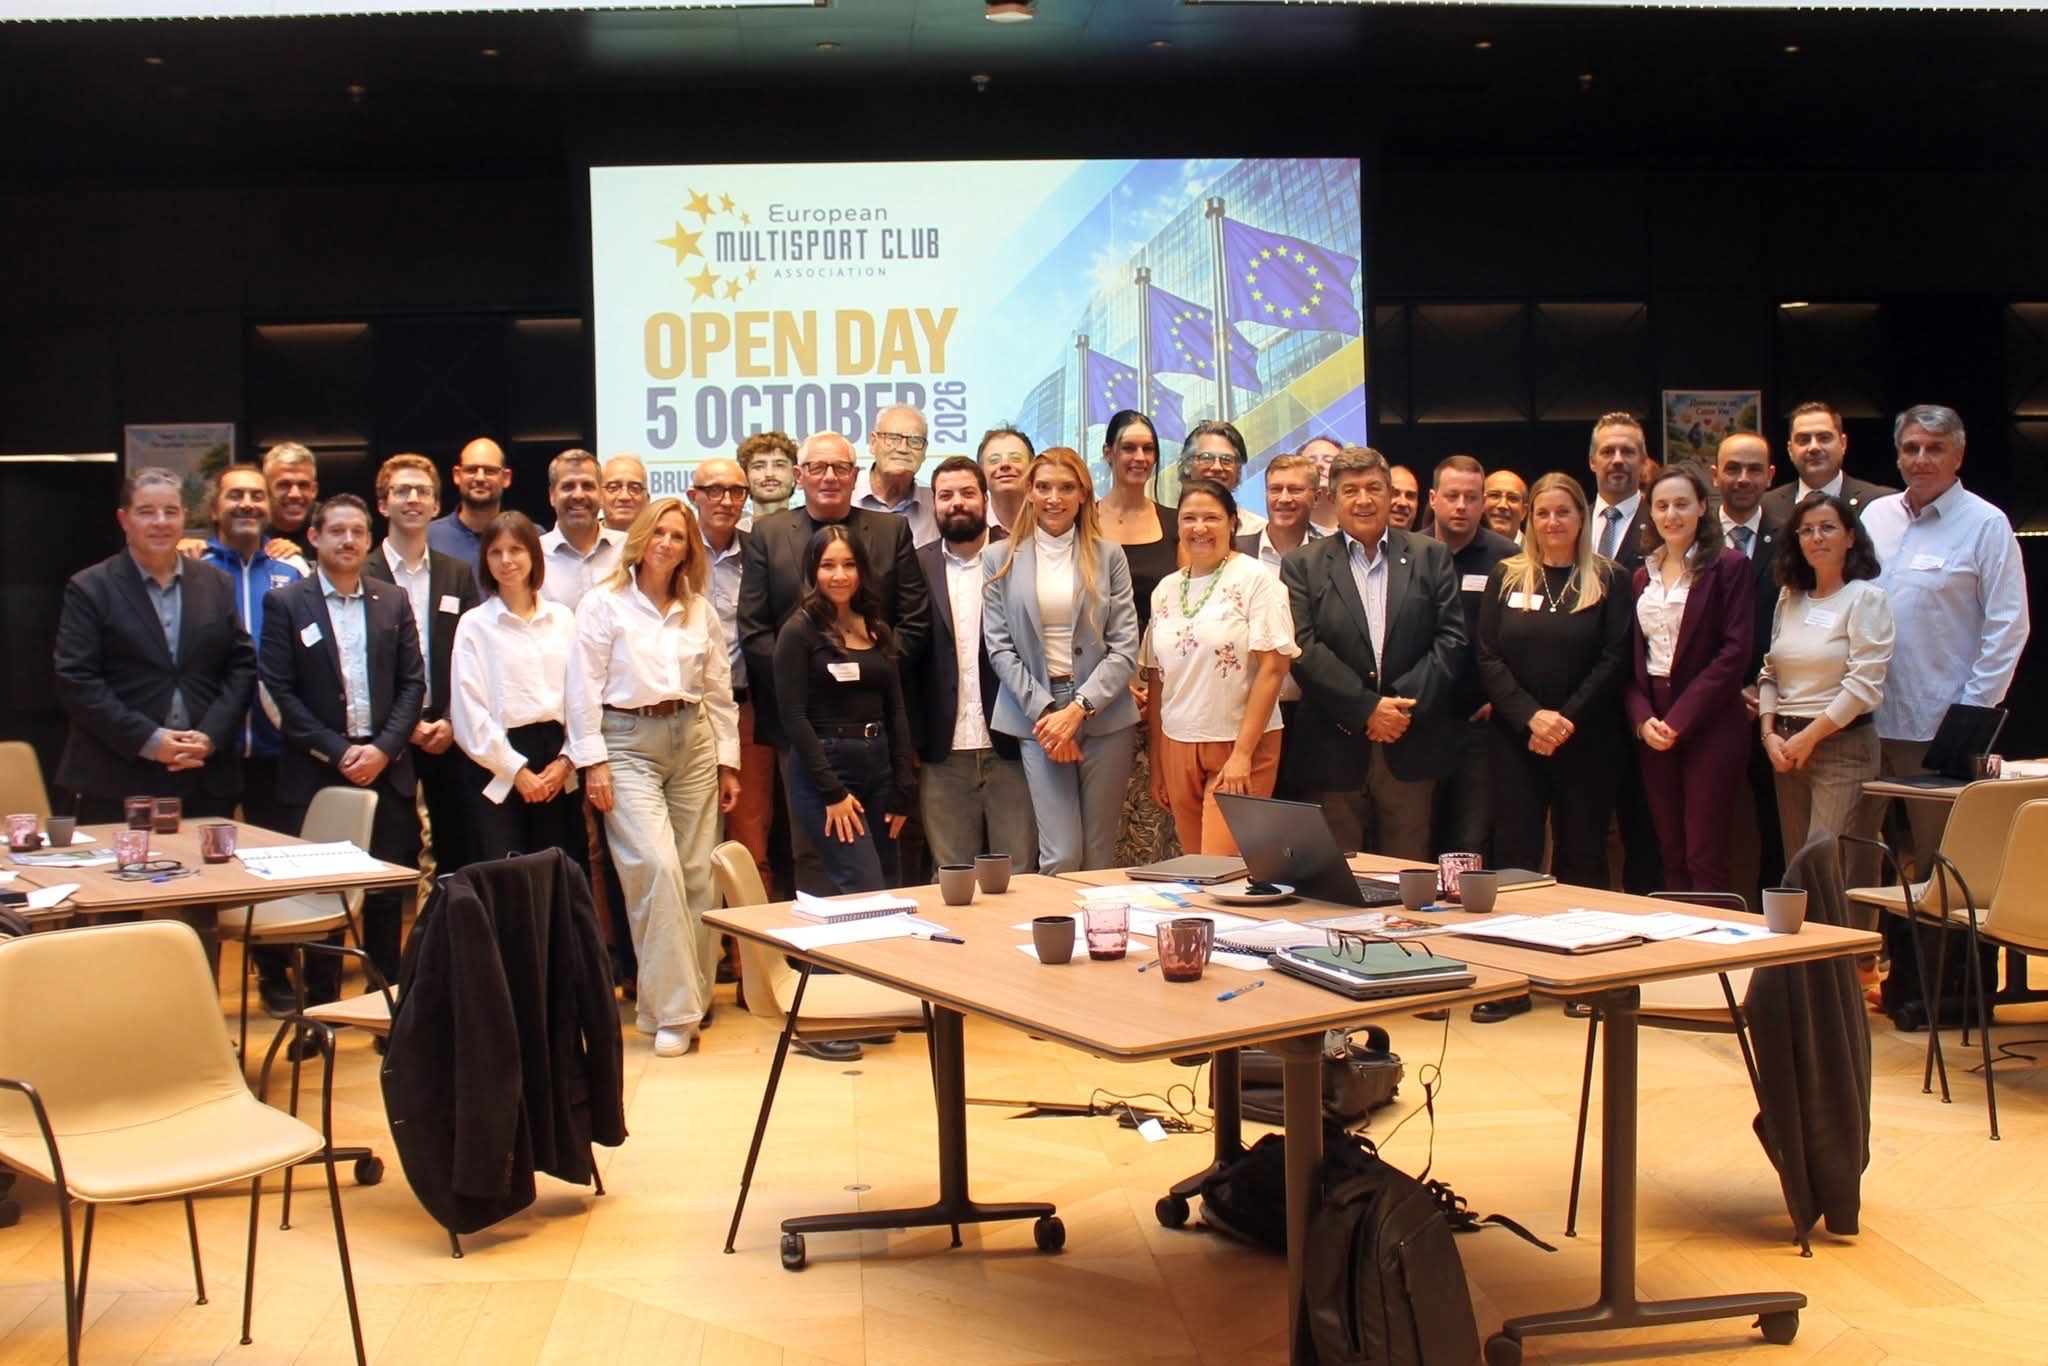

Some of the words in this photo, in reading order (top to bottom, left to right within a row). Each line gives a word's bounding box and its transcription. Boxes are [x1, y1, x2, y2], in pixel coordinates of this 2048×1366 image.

[768, 204, 888, 225] European
[716, 229, 868, 262] MULTISPORT
[882, 228, 940, 259] CLUB
[773, 267, 887, 278] ASSOCIATION
[643, 310, 818, 380] OPEN
[835, 308, 959, 376] DAY
[646, 387, 678, 450] 5
[933, 381, 968, 444] 2026
